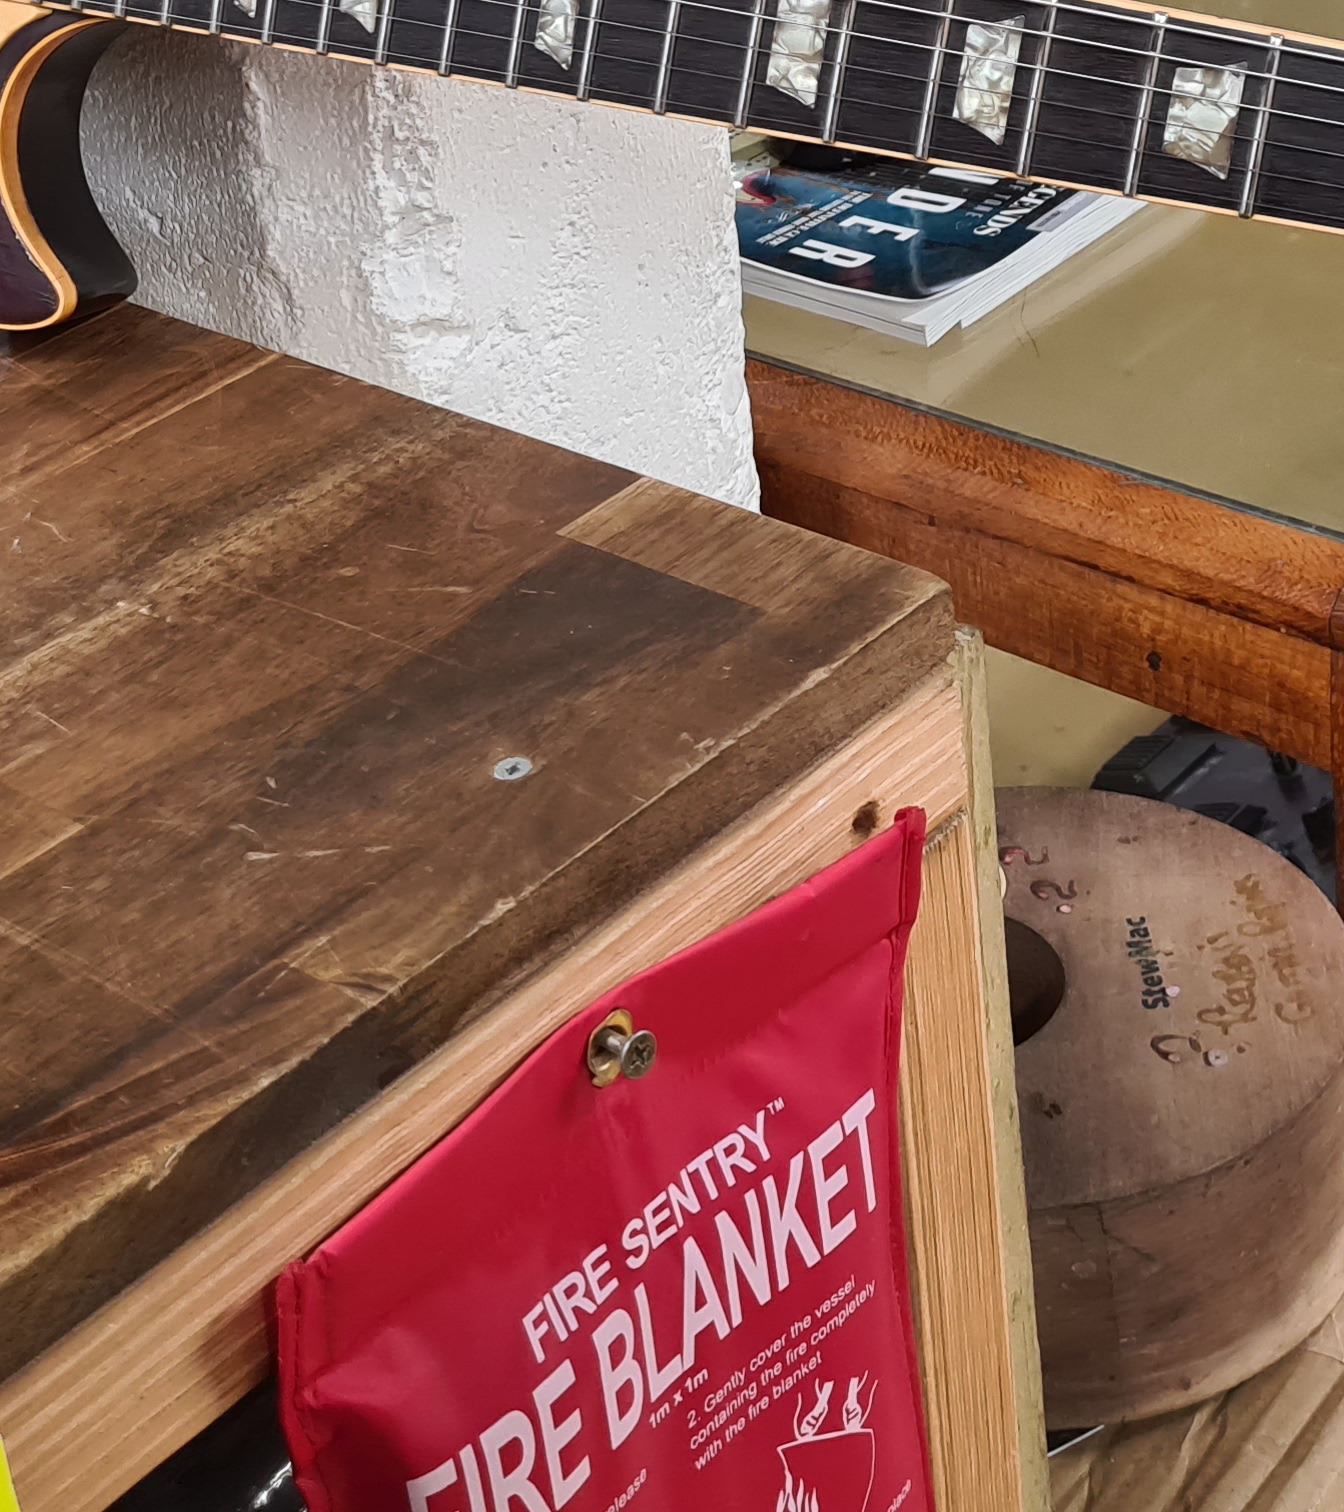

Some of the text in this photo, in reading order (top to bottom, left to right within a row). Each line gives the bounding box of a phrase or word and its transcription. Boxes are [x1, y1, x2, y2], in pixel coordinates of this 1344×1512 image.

[789, 166, 1006, 268] NDER
[973, 186, 1059, 237] GENDS
[1125, 915, 1170, 1011] StewMac
[522, 1244, 620, 1364] FIRE
[591, 1088, 877, 1451] BLANKET
[649, 1368, 709, 1429] 1m x 1m
[686, 1274, 856, 1429] 2. Gently cover the vessel
[690, 1280, 876, 1450] containing the fire completely
[695, 1350, 823, 1471] with the fire blanket
[605, 1467, 647, 1512] elease
